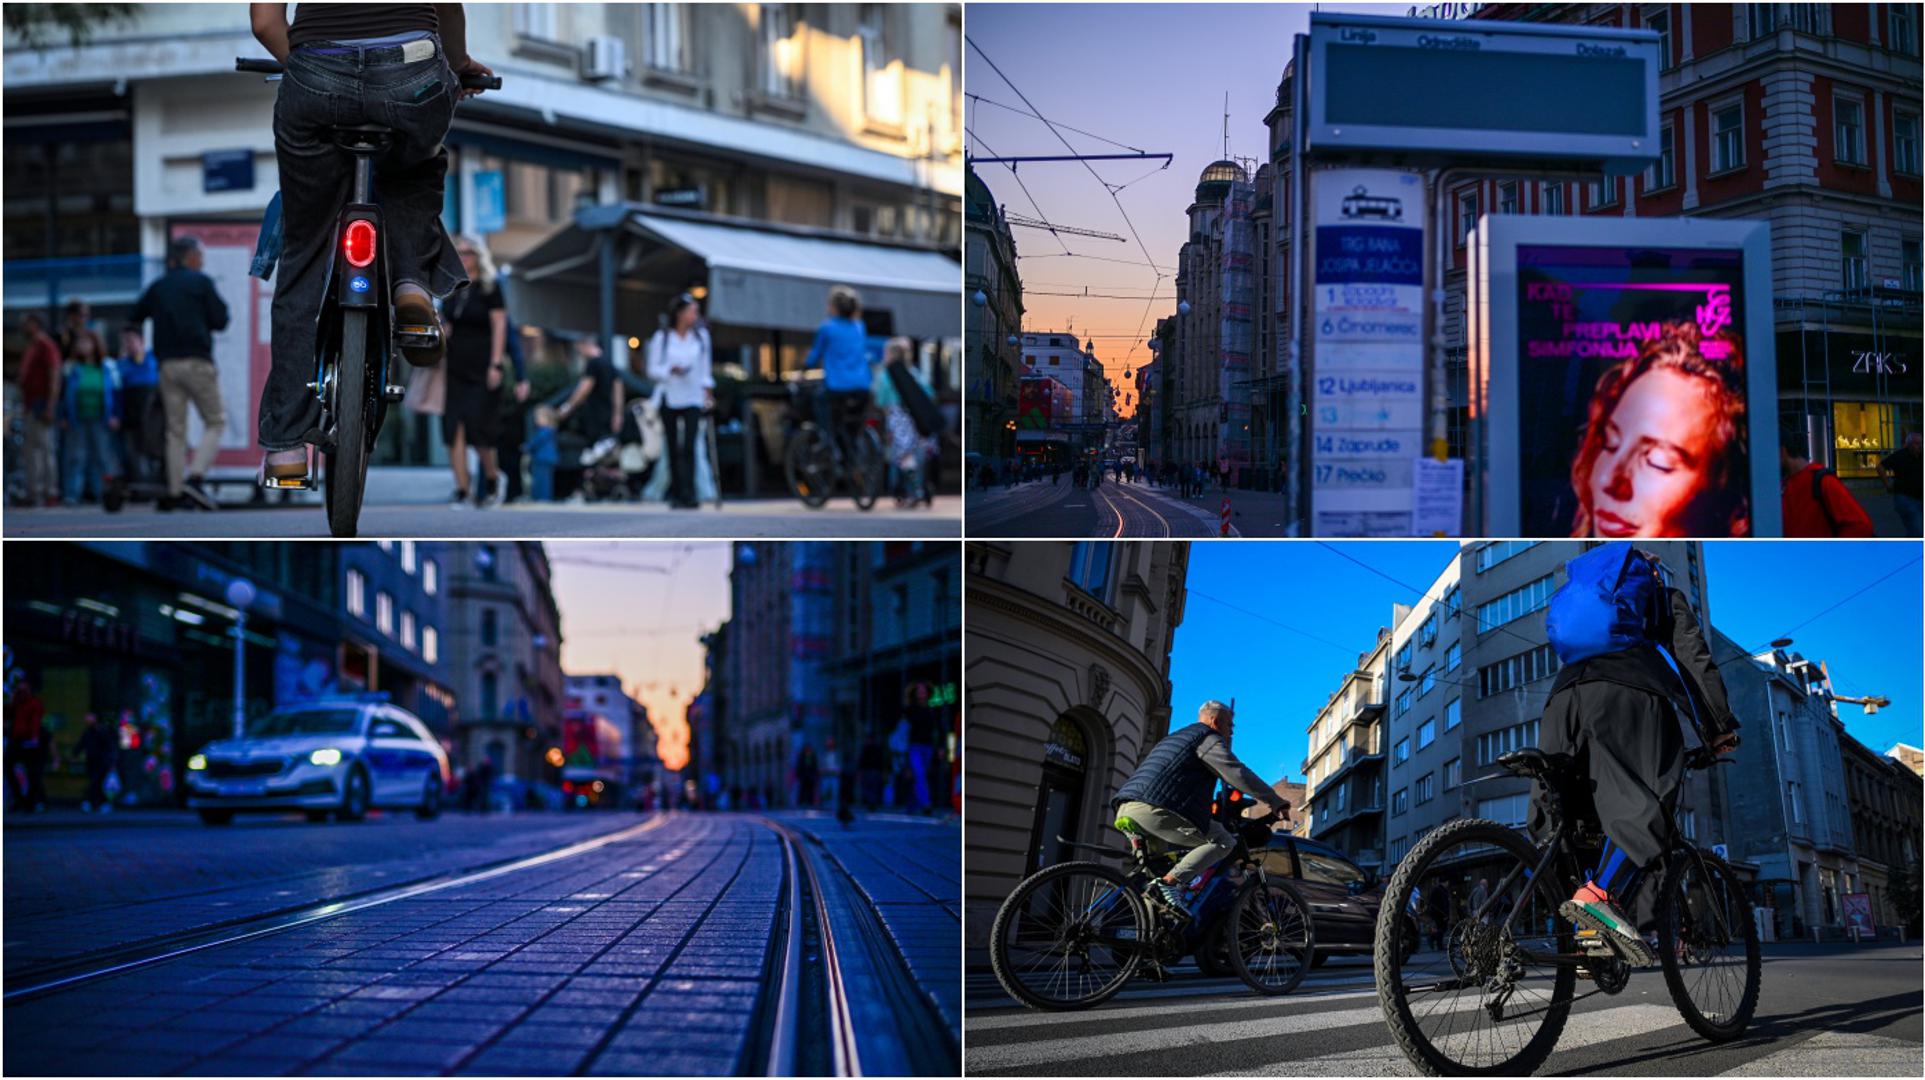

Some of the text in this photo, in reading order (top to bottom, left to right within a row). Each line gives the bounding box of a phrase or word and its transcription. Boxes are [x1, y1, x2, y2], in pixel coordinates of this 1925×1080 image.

[1328, 287, 1335, 303] 1
[1321, 319, 1334, 335] 6
[1562, 322, 1660, 340] PREPLAVI
[1528, 341, 1639, 358] SIMFONIJA
[1319, 377, 1335, 395] 12
[1319, 406, 1338, 424] 13
[1316, 436, 1333, 453] 14
[1316, 465, 1333, 483] 17
